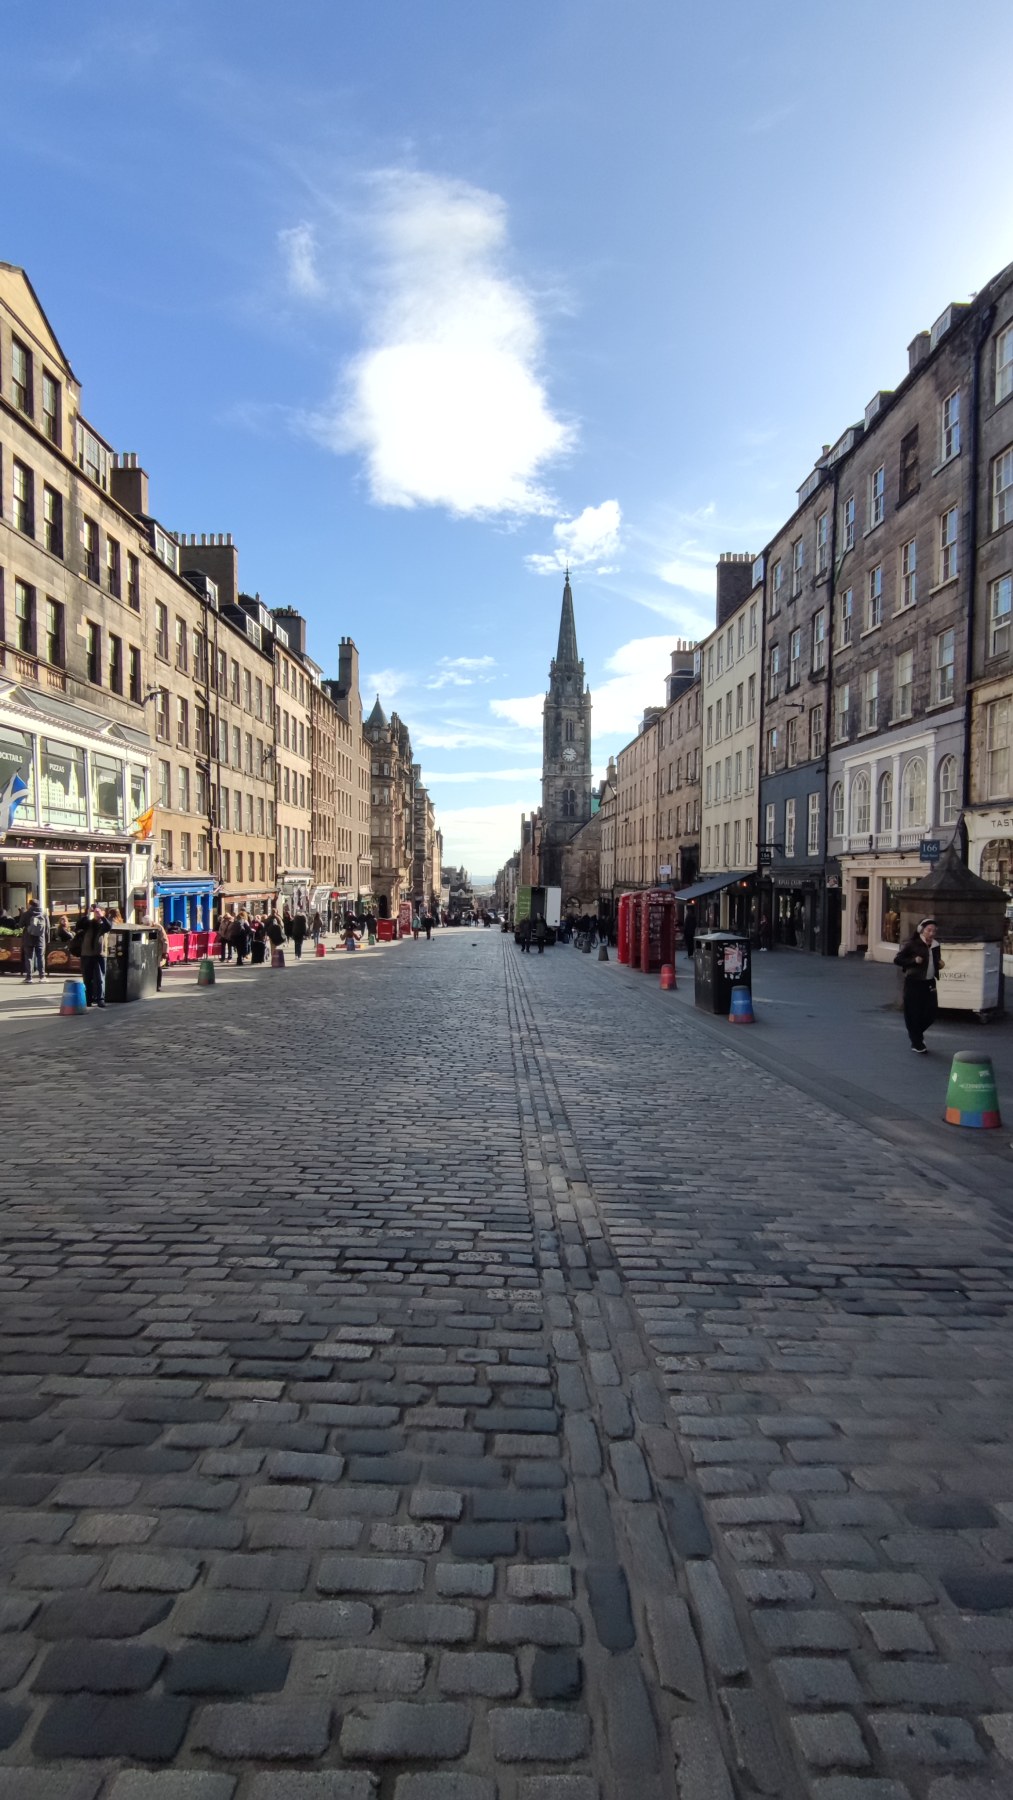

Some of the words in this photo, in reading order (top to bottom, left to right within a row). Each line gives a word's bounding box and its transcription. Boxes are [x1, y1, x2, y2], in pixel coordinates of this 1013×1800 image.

[991, 818, 1013, 828] TAST
[16, 837, 36, 848] THE
[44, 840, 80, 850] FILLING
[86, 842, 117, 852] STATION
[923, 843, 938, 852] 166
